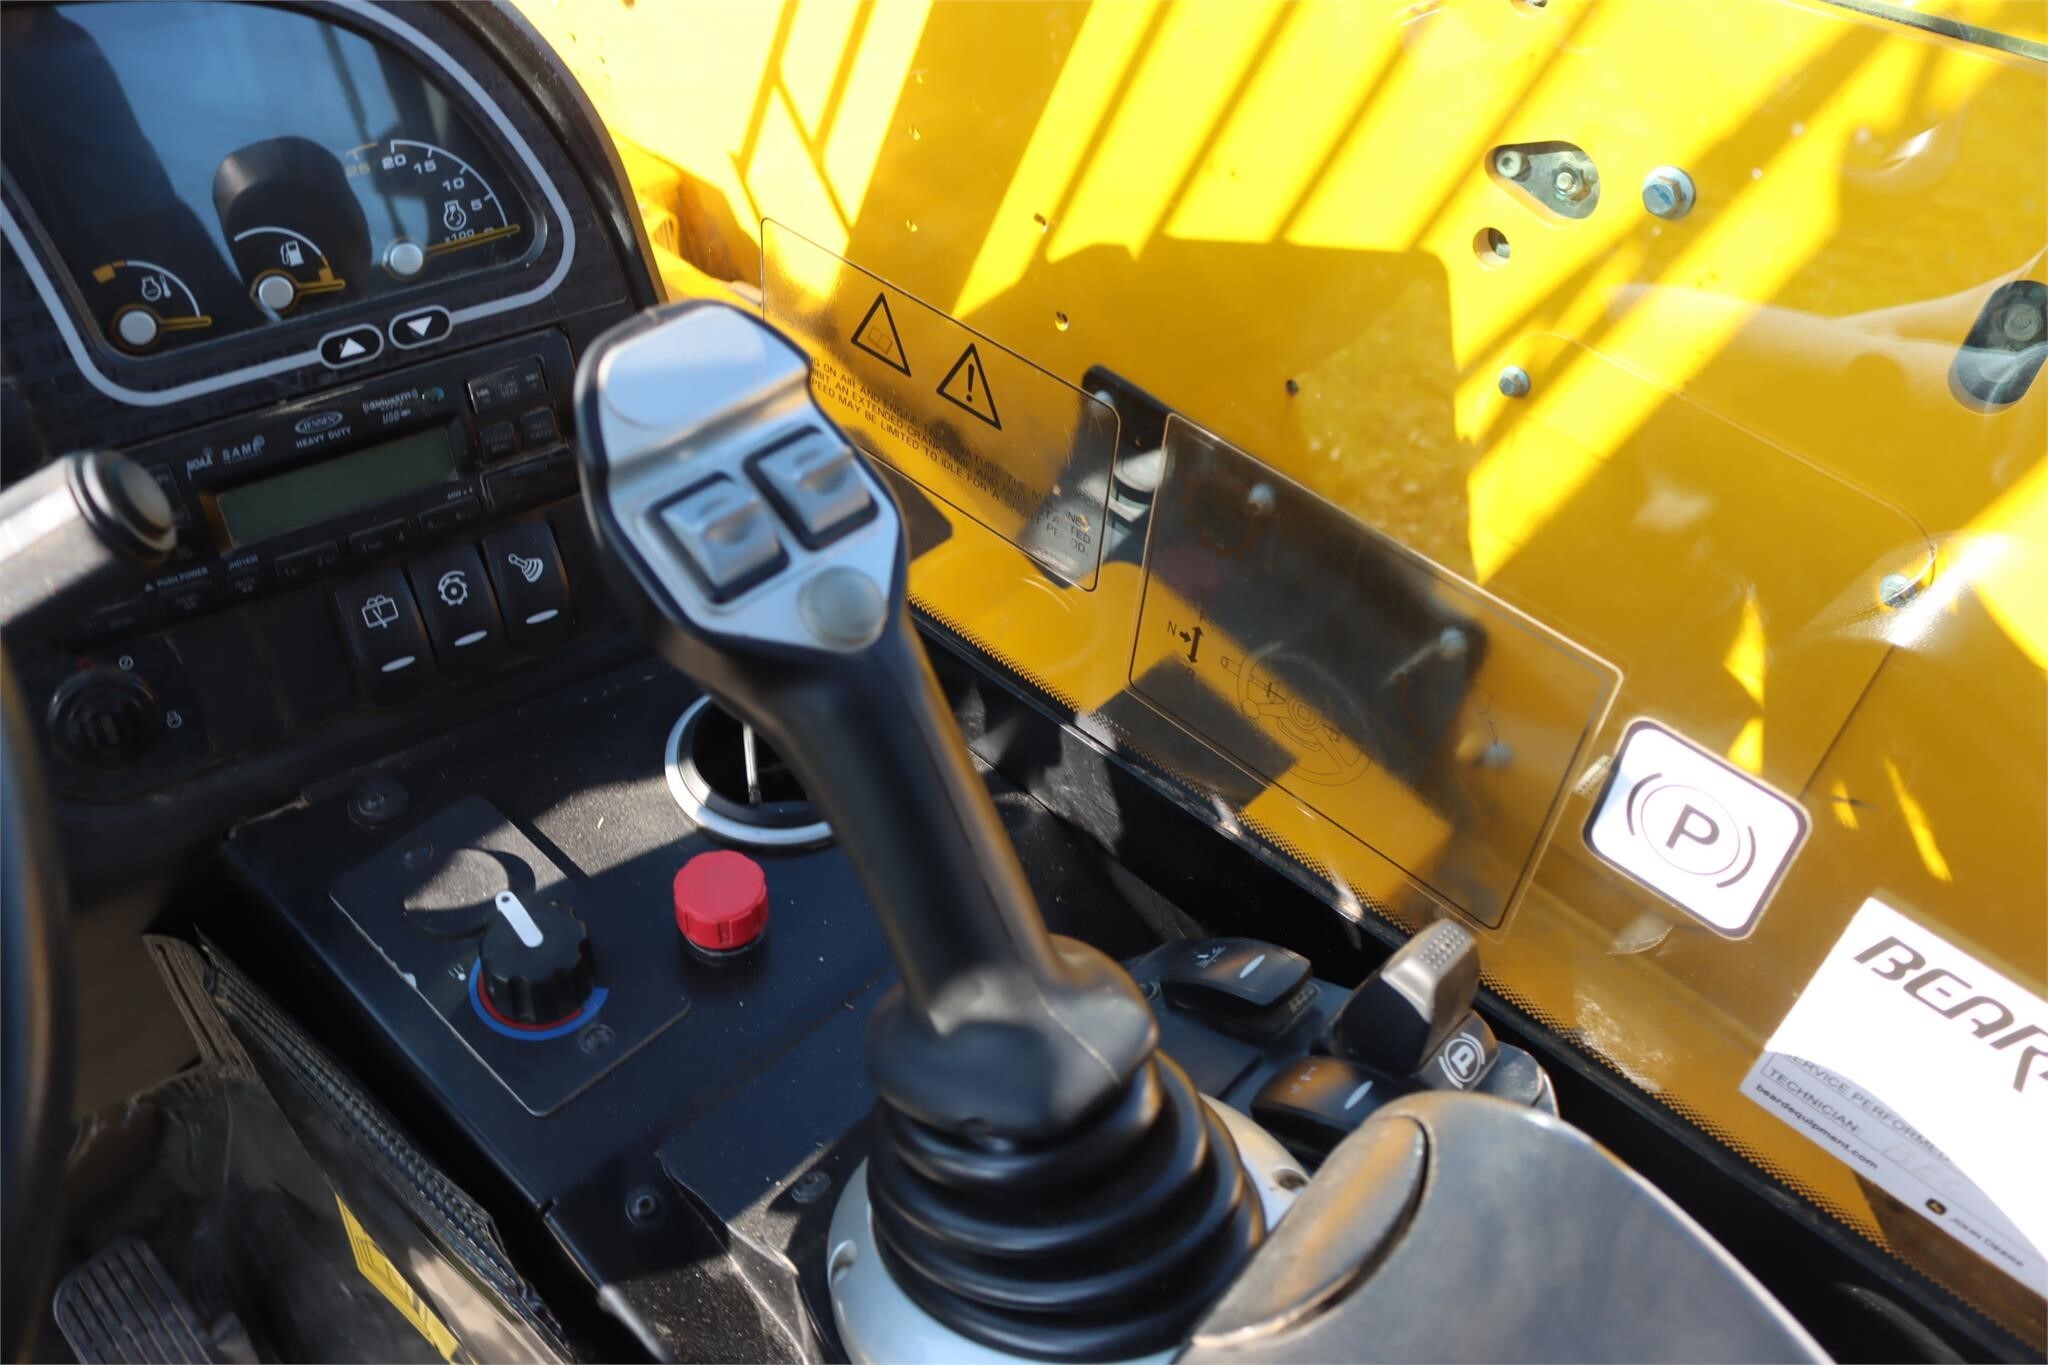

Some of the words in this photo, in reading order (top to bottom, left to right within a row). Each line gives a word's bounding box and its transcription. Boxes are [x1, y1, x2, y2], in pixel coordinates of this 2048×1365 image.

[381, 153, 407, 170] 20
[413, 159, 437, 174] 15
[443, 177, 465, 191] 10
[470, 199, 483, 211] 5
[812, 367, 831, 384] IBIT
[835, 381, 849, 396] AN
[852, 391, 904, 429] EXTENDED
[907, 424, 941, 451] CRANK
[822, 361, 837, 378] ON
[840, 372, 857, 389] AIR
[860, 385, 882, 404] AND
[884, 399, 918, 425] ENGINE
[295, 433, 325, 449] HEAVY
[328, 426, 351, 441] DUTY
[811, 378, 835, 399] PEED
[838, 393, 861, 414] MAY
[864, 410, 878, 424] BE
[880, 420, 919, 450] LIMITED
[923, 446, 938, 462] TO
[941, 458, 963, 477] IDLE
[967, 472, 987, 492] FOR
[156, 574, 179, 588] PUSH
[179, 566, 208, 581] POWER
[1166, 619, 1177, 636] N
[1665, 803, 1720, 850] P
[1853, 935, 2048, 1093] BEAR
[1450, 1045, 1476, 1077] P
[1789, 1055, 1849, 1094] ERVICE
[1769, 1067, 1860, 1132] TECHNICIAN
[1756, 1084, 1879, 1170] beardequipment.com
